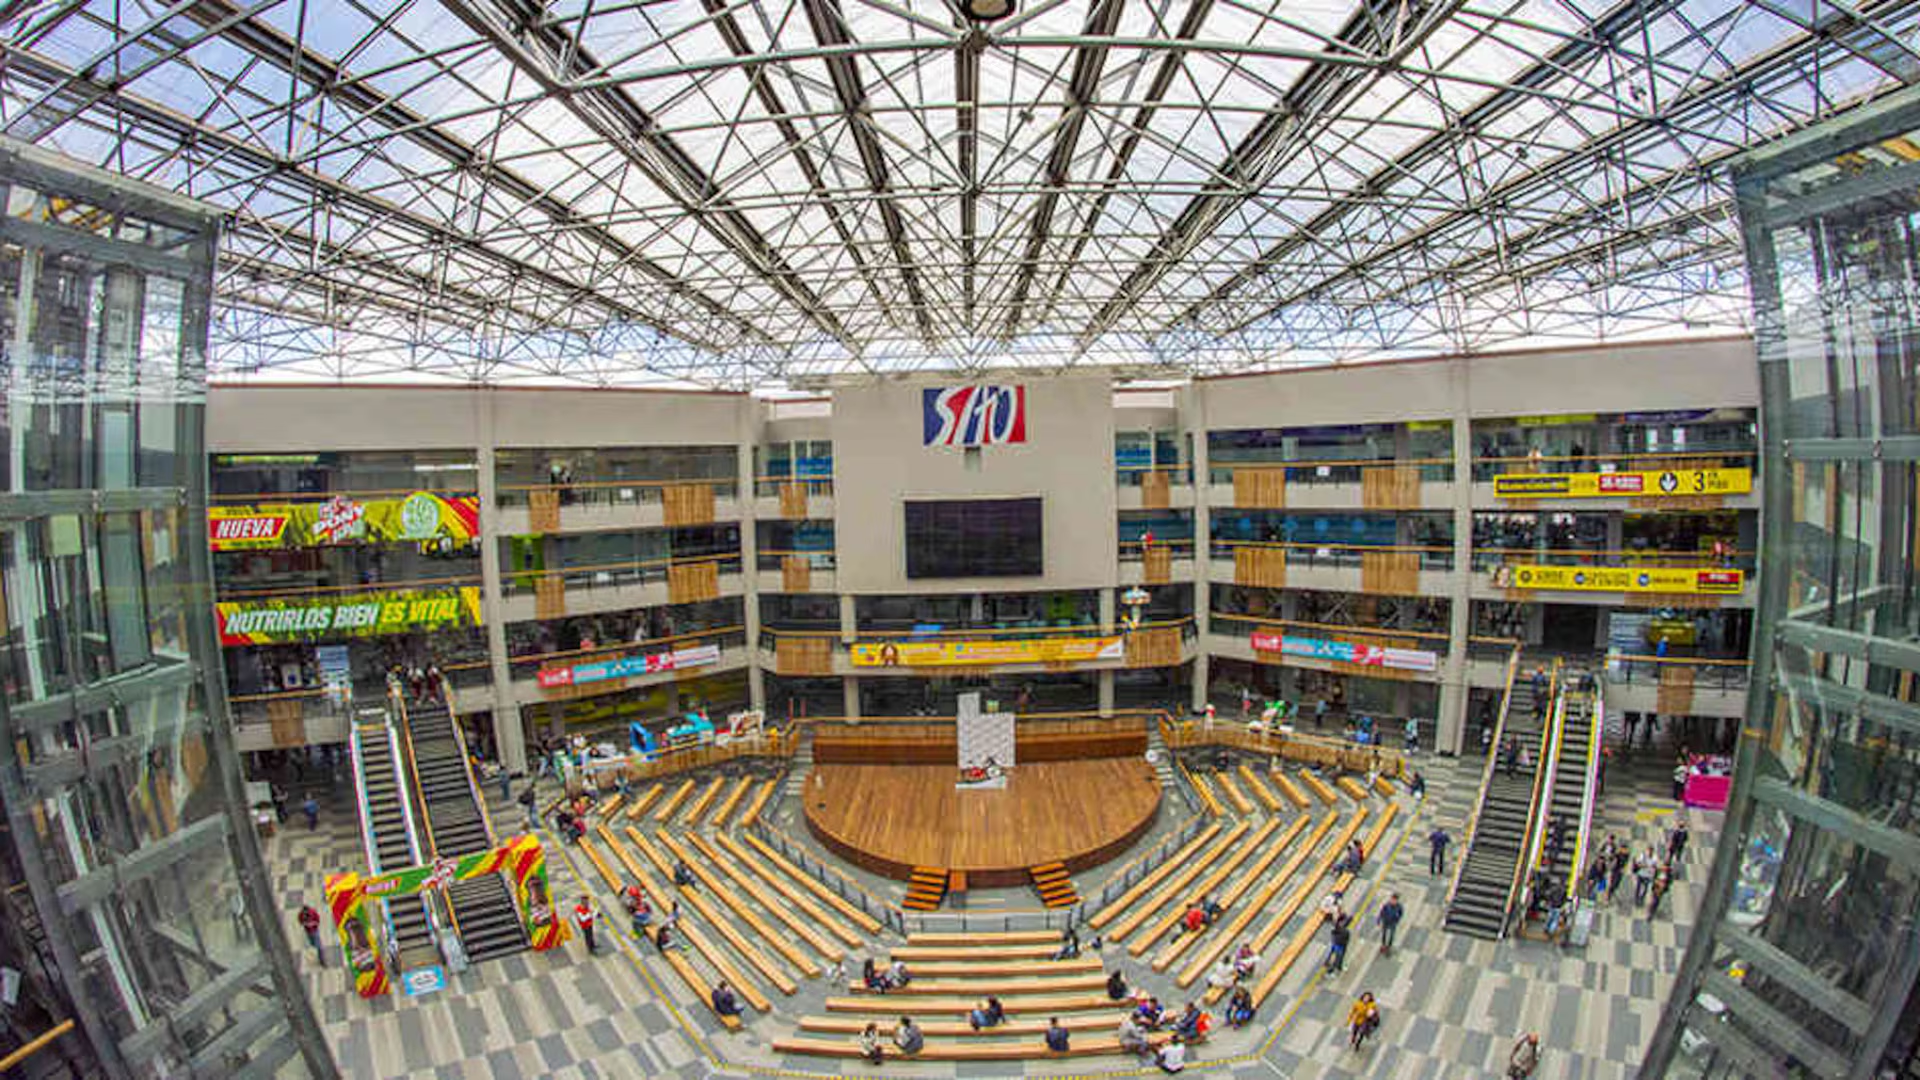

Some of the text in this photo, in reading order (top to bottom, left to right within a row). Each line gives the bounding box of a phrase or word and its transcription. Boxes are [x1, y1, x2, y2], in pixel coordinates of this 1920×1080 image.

[1693, 471, 1704, 492] 3
[216, 517, 275, 538] NUEVA
[225, 598, 459, 635] NUTRIRLOS BIEN ES VITAL
